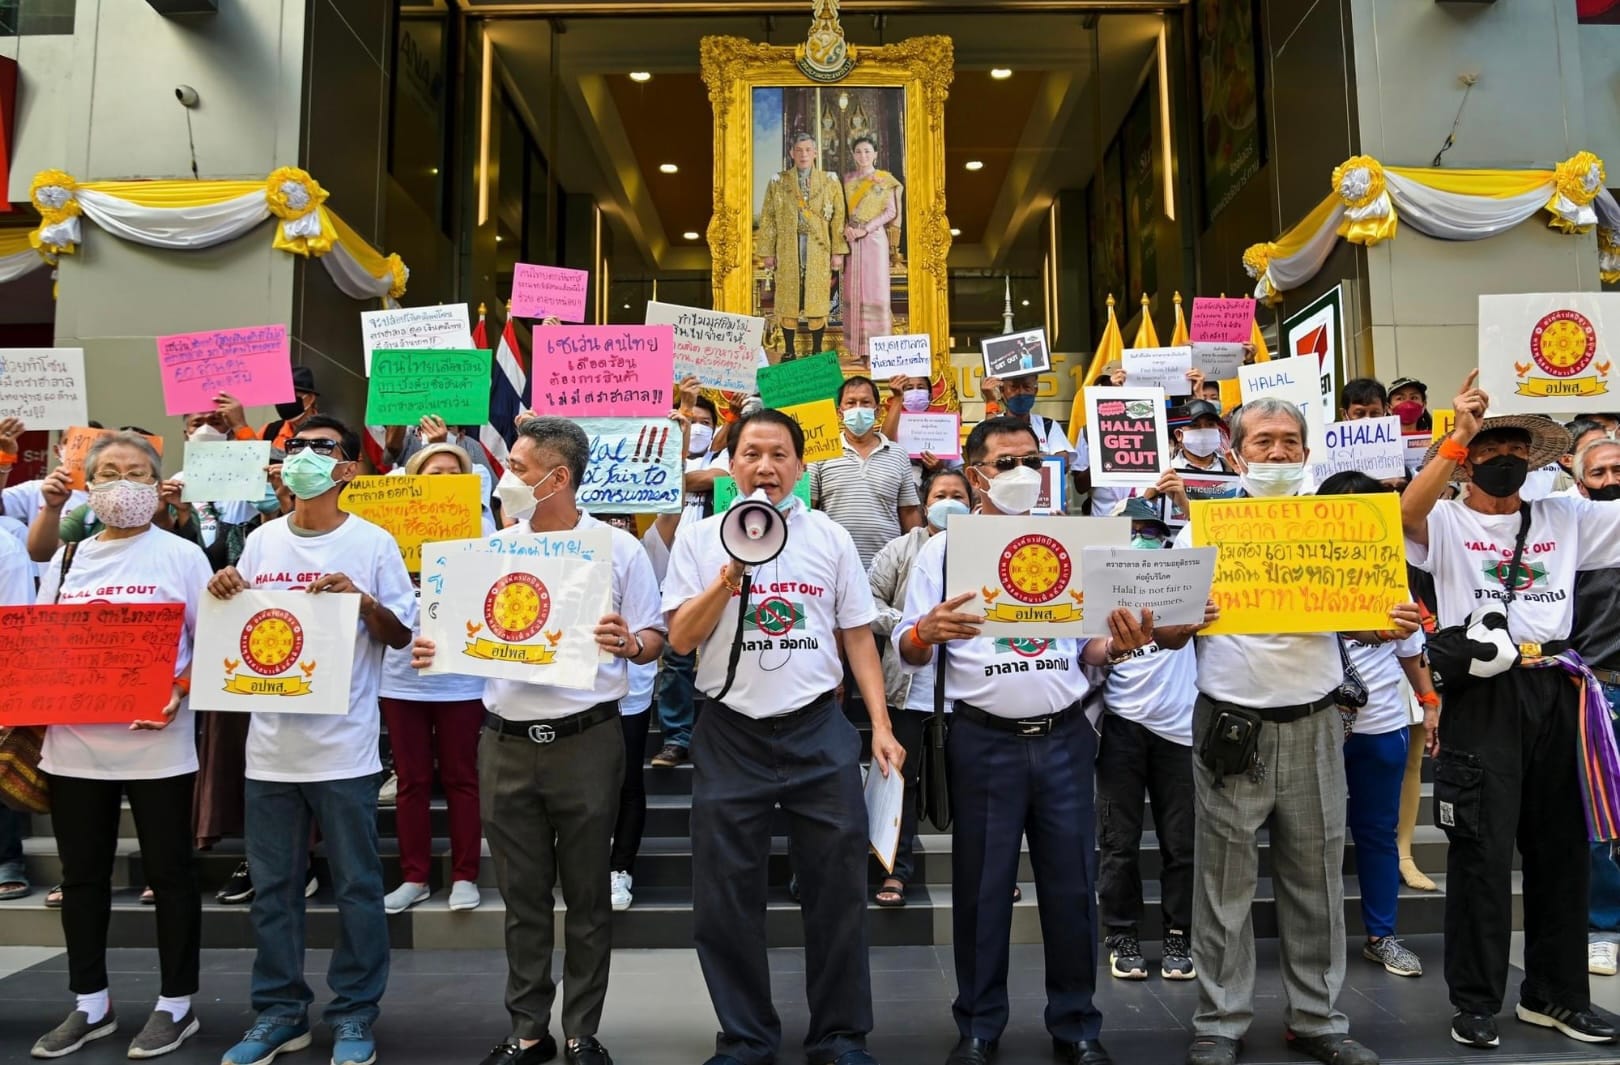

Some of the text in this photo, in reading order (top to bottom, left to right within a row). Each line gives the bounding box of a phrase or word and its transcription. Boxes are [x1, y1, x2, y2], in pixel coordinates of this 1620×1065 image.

[604, 332, 658, 352] คนไทย
[1248, 372, 1295, 392] HALAL
[1546, 381, 1583, 394] อปพส.
[1100, 420, 1155, 432] HALAL
[1104, 434, 1144, 449] GET
[1341, 423, 1397, 447] HALAL
[1114, 450, 1157, 465] OUT
[644, 465, 667, 486] to
[349, 479, 375, 490] HALAL
[378, 477, 396, 487] GET
[1210, 502, 1359, 522] HALAL GET OUT
[255, 572, 293, 585] HALAL
[296, 572, 321, 583] GET
[95, 586, 123, 596] GET
[126, 585, 157, 595] OUT
[769, 582, 797, 593] GET
[798, 583, 825, 597] OUT
[1112, 584, 1137, 594] Halal
[1148, 586, 1164, 594] not
[1166, 584, 1181, 593] fair
[1117, 598, 1133, 608] the
[1015, 608, 1057, 620] อปพส.
[779, 637, 819, 650] ออกไป
[491, 645, 530, 660] อปพส.
[984, 657, 1069, 677] ฮาลาล ออกไป
[251, 679, 288, 693] อปพส.
